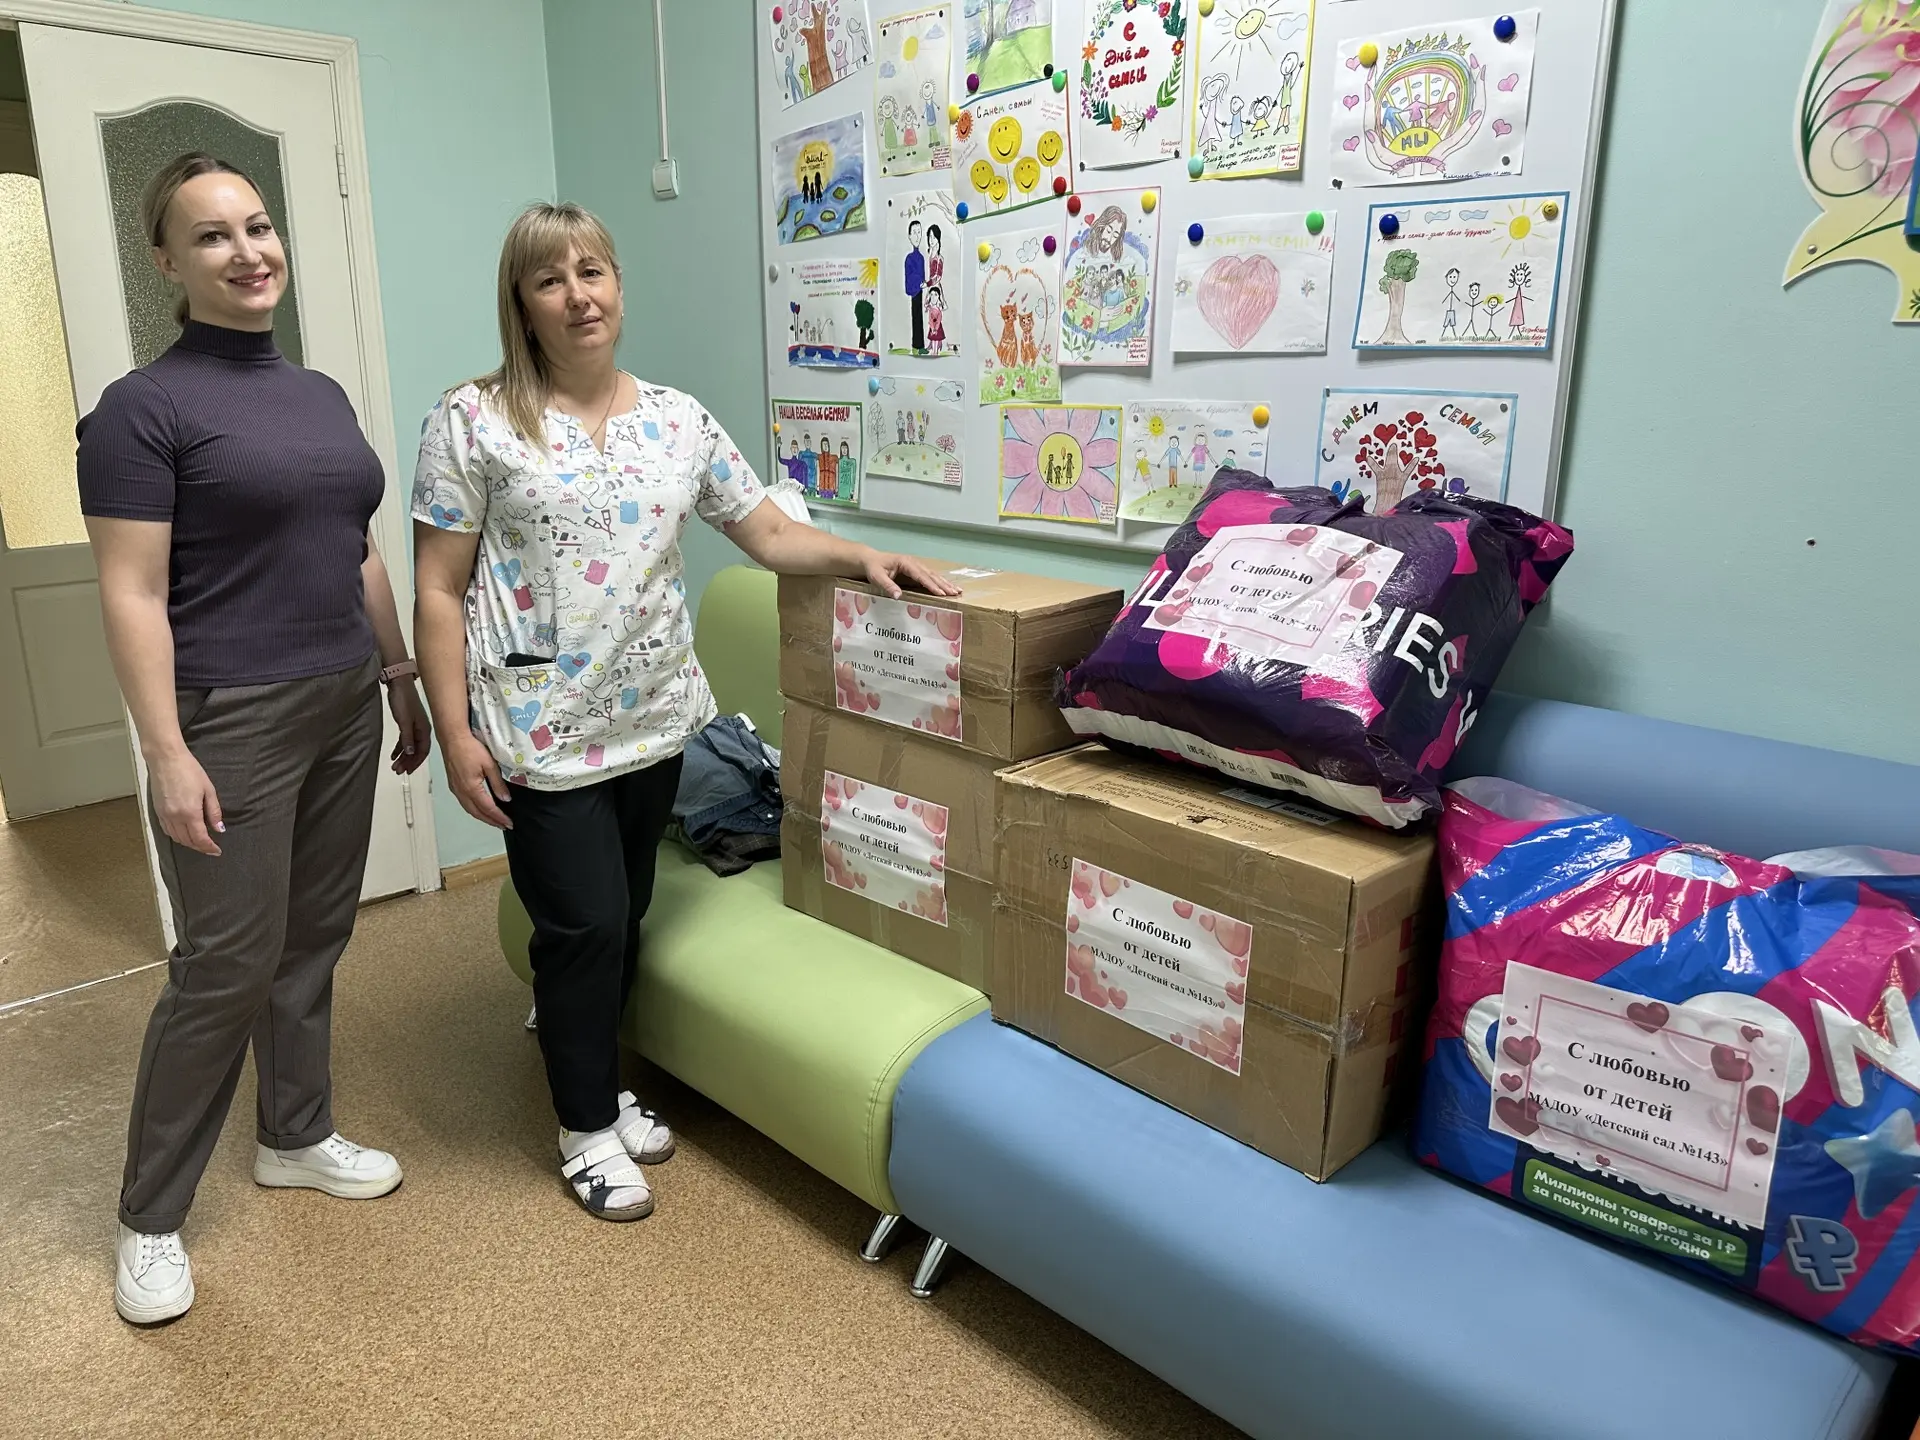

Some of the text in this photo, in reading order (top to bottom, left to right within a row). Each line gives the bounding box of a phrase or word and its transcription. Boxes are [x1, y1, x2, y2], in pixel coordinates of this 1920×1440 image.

[1123, 22, 1137, 41] С
[1401, 131, 1429, 151] МЫ
[778, 405, 795, 420] НАША
[1322, 448, 1335, 463] С
[1439, 403, 1497, 447] СЕМЬИ
[1231, 559, 1313, 585] С любовью
[1230, 584, 1249, 595] от
[865, 622, 921, 645] С любовью
[873, 649, 915, 667] от детей
[851, 661, 875, 673] МАДОУ
[877, 668, 907, 681] «Детский
[907, 676, 919, 685] сад
[852, 806, 907, 834] С любовью
[838, 841, 861, 855] МАДОУ
[863, 851, 892, 866] «Детский
[859, 833, 899, 854] от детей
[1112, 907, 1192, 950] С любовью
[1123, 941, 1181, 973] от детей
[1090, 945, 1219, 1008] МАДОУ «Детский сад №143»
[1568, 1042, 1691, 1093] С любовью
[1583, 1083, 1673, 1122] от детей
[1528, 1091, 1729, 1167] МАДОУ «Детский сад №143»
[1533, 1168, 1617, 1212] Миллионы
[1621, 1205, 1688, 1238] товаров
[1692, 1233, 1712, 1247] за
[1531, 1183, 1711, 1260] за покупки где угодно
